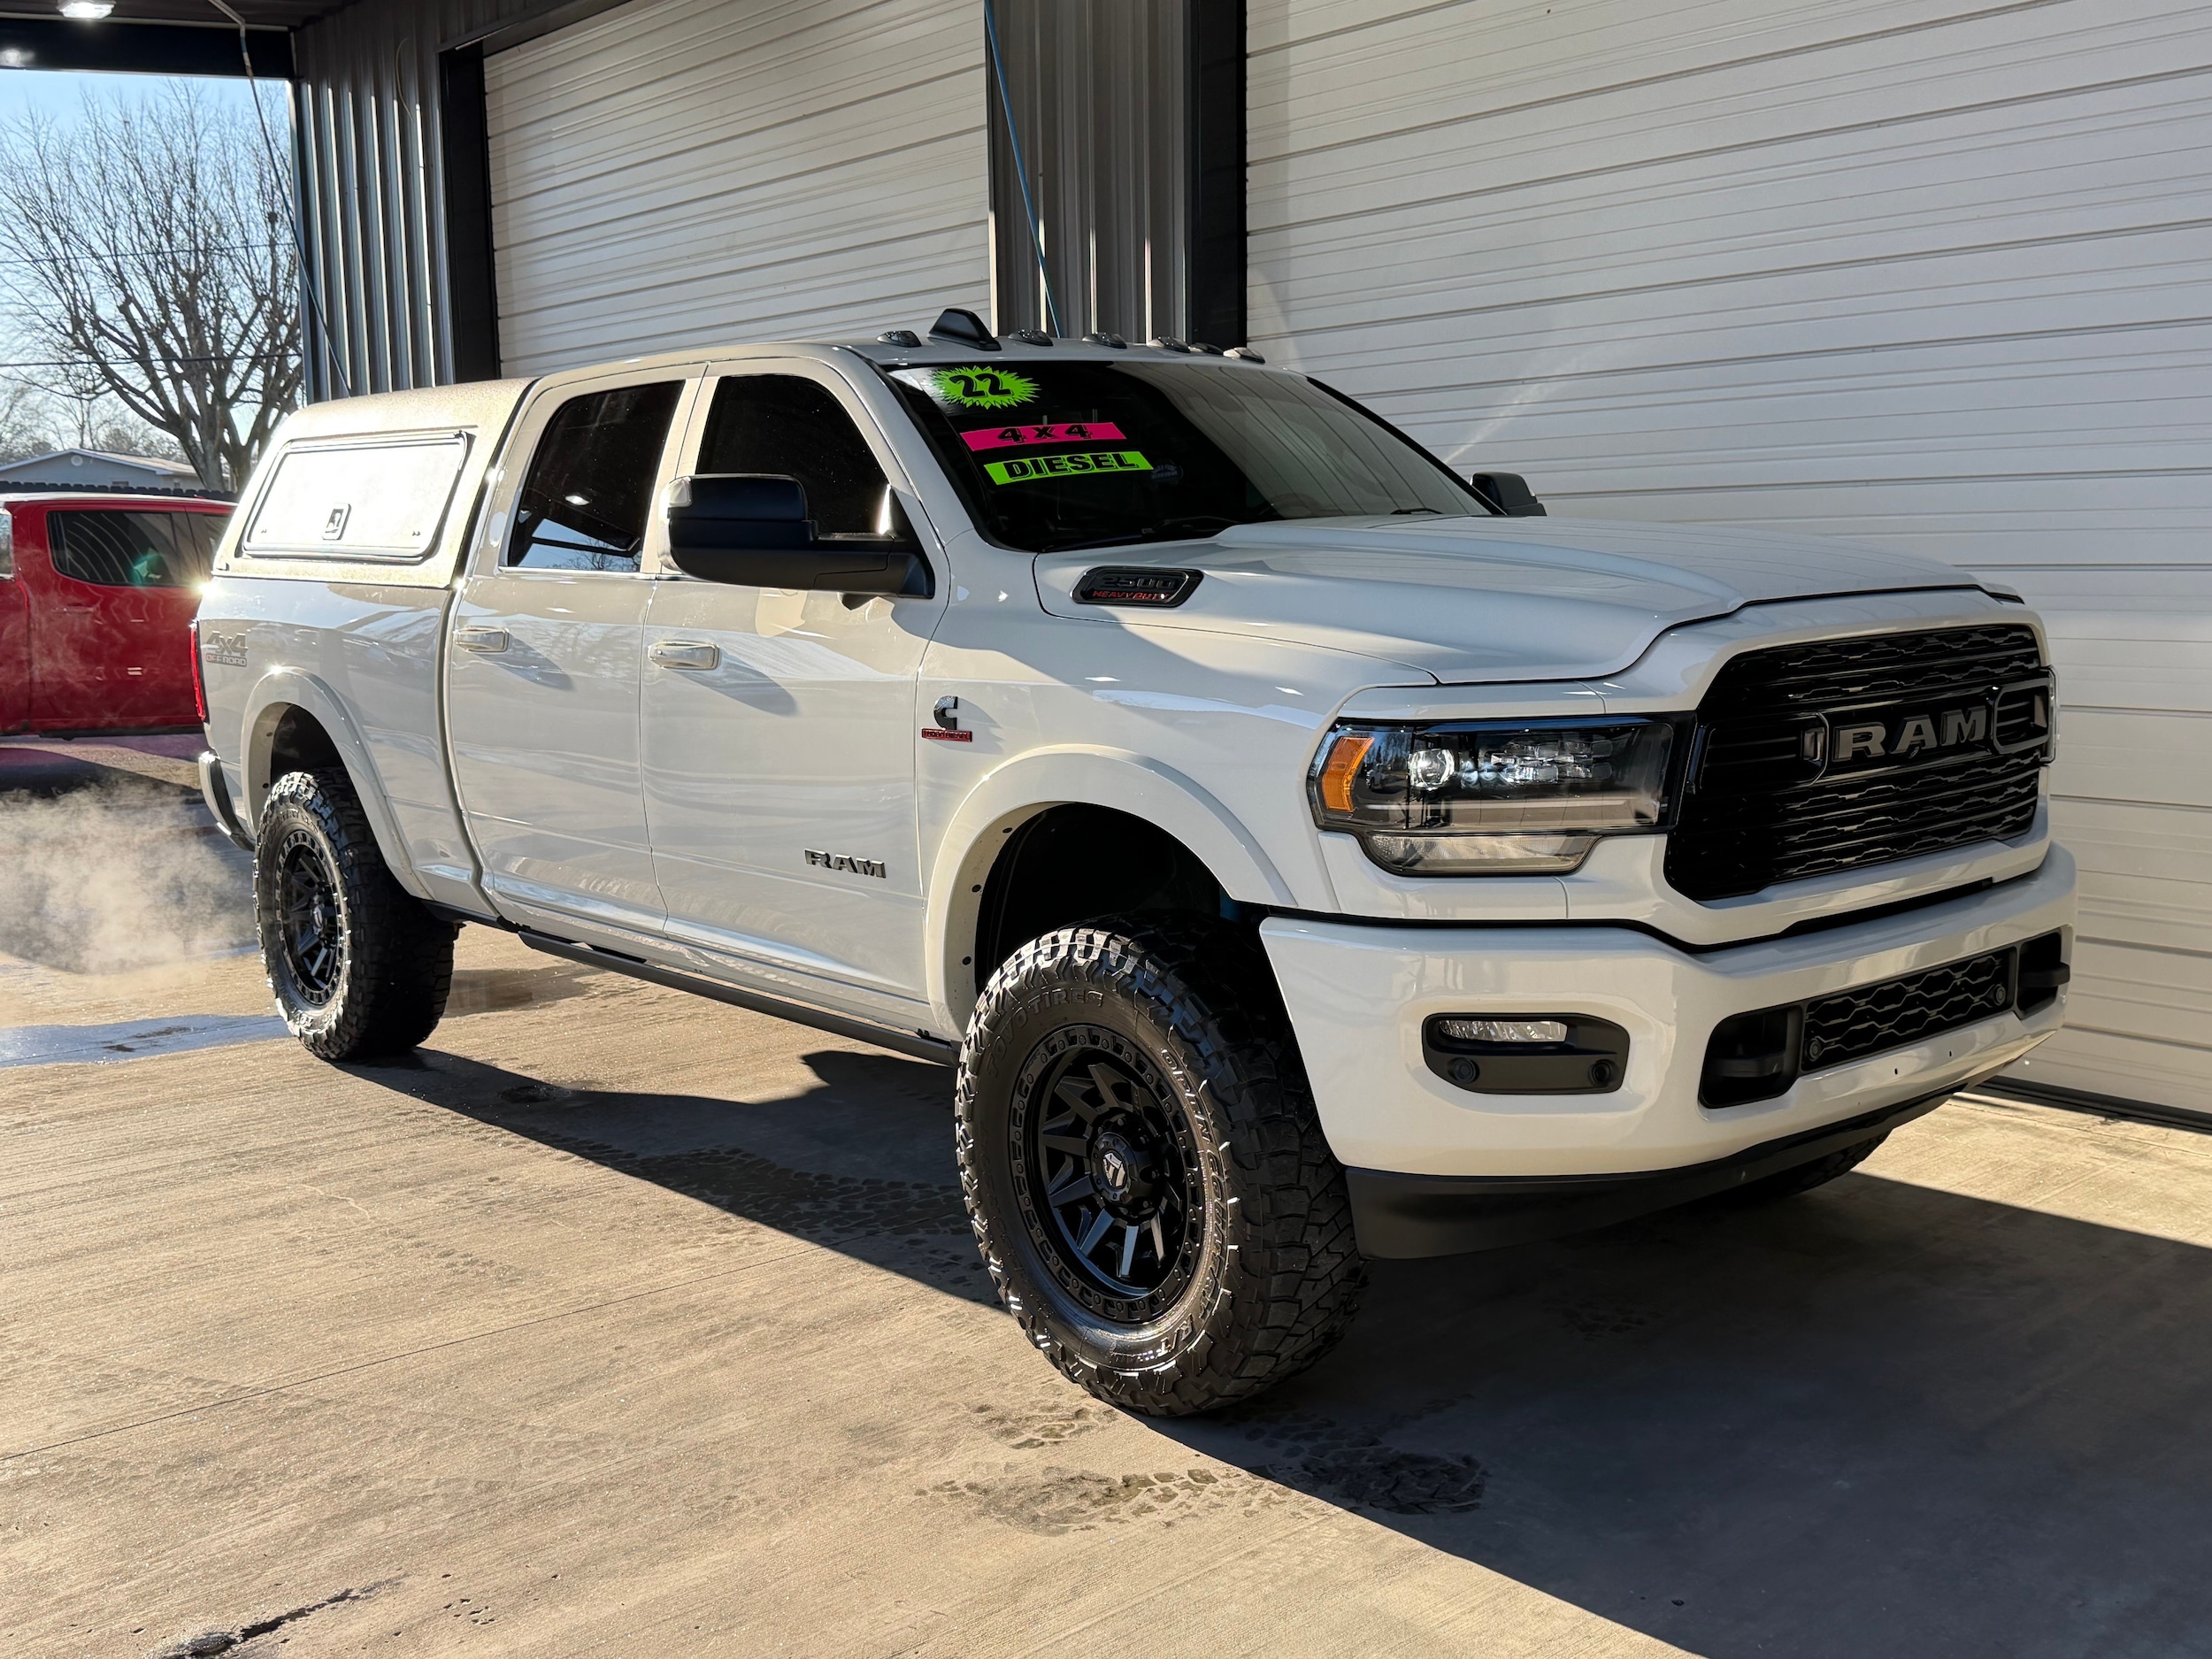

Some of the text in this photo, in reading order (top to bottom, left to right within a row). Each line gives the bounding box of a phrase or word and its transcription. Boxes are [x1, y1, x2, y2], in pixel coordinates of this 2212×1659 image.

[949, 373, 1014, 398] 22
[1002, 452, 1140, 480] DIESEL
[1092, 590, 1133, 599] HEAVY
[1100, 576, 1177, 590] 2500
[206, 654, 247, 667] OFF ROAD
[1832, 705, 1988, 763] RAM
[803, 848, 887, 879] RAM
